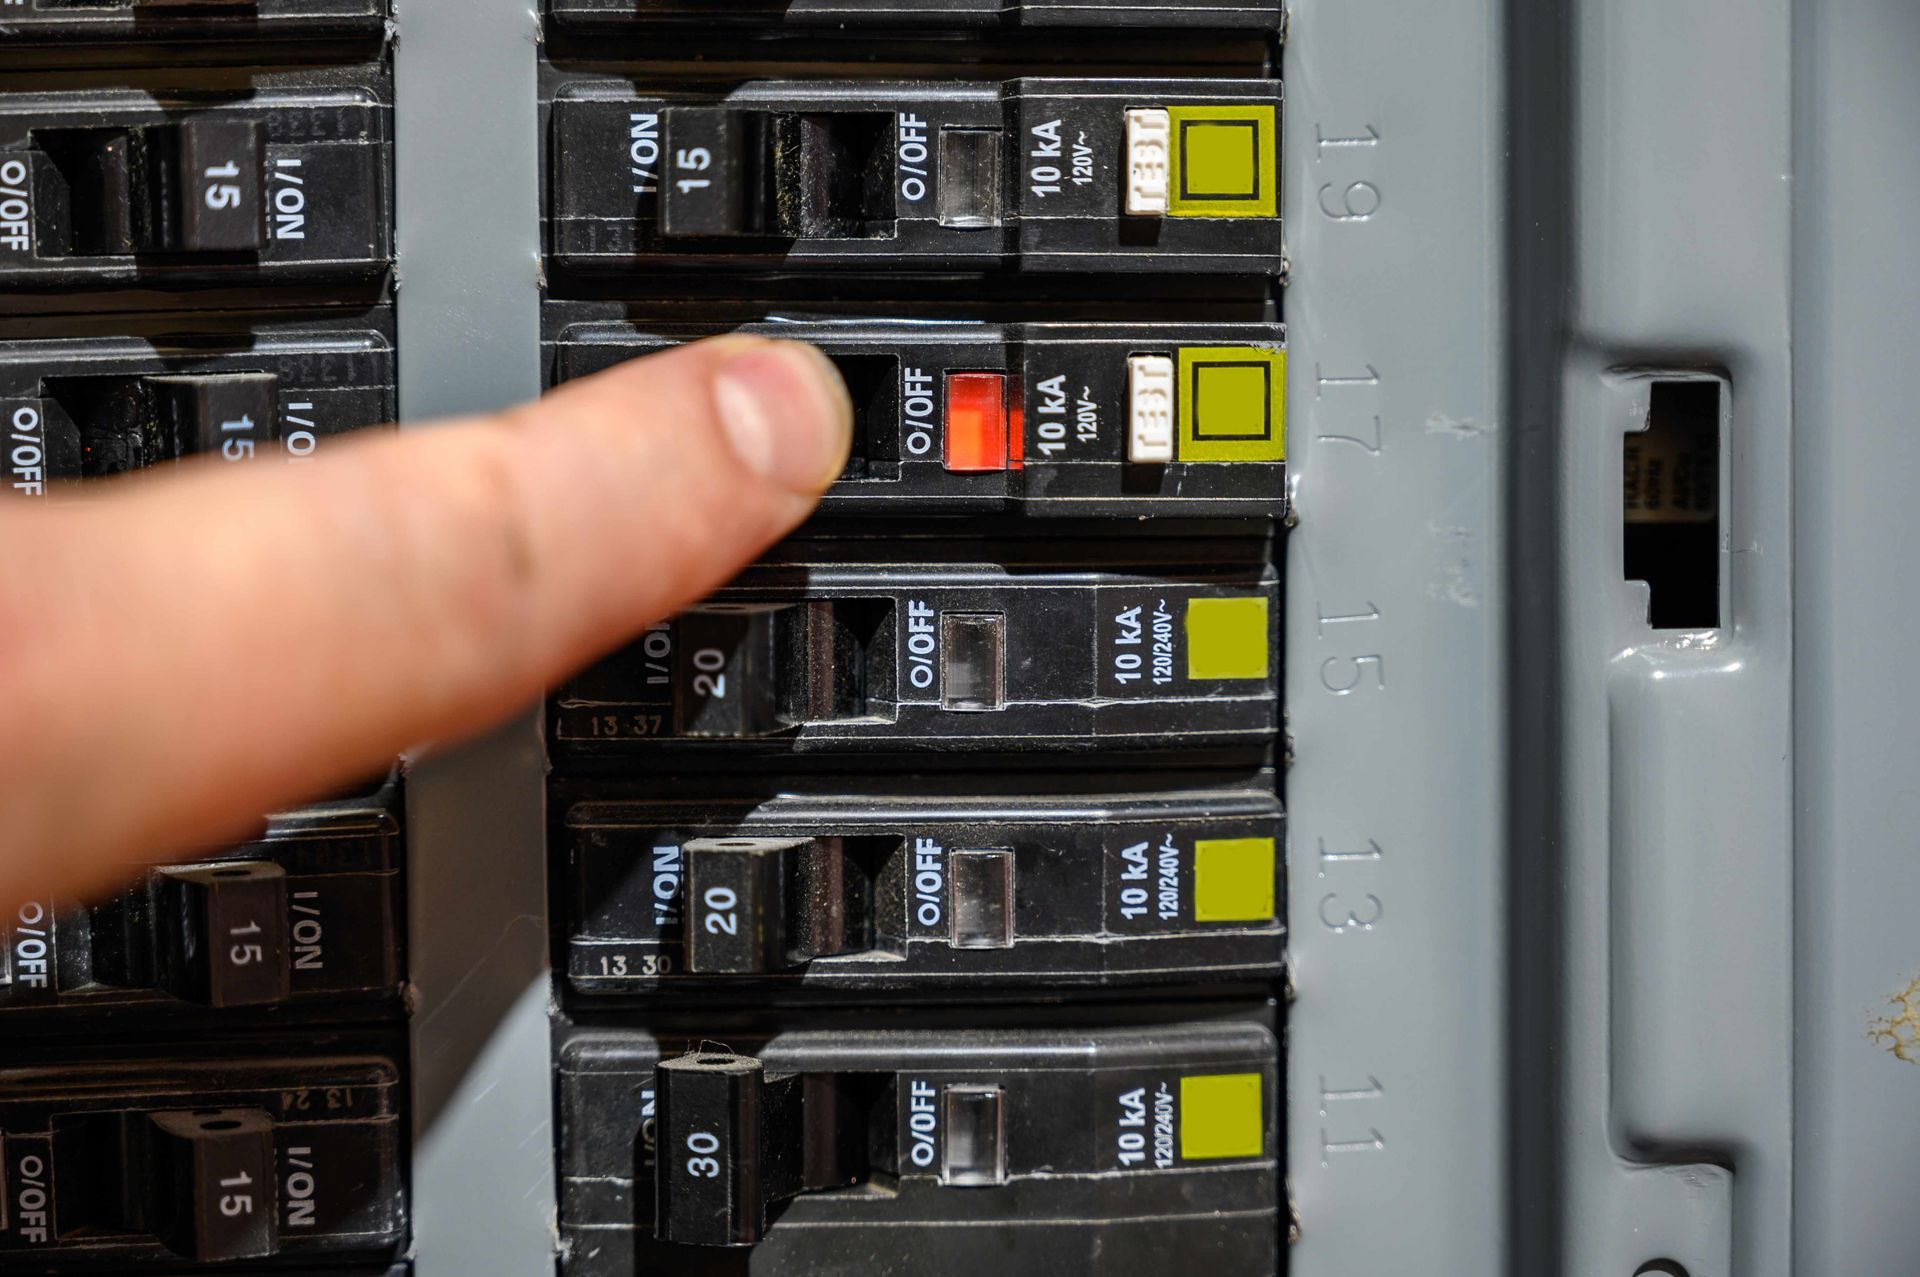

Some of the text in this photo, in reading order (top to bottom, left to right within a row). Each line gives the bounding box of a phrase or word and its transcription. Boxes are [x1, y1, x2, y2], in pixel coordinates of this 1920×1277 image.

[205, 161, 240, 209] 15
[631, 114, 658, 192] I/ON
[677, 148, 710, 193] 15
[899, 113, 927, 200] O/OFF
[1031, 120, 1061, 197] 10 kA
[1315, 122, 1381, 222] 19
[0, 161, 29, 250] O/OFF
[275, 159, 304, 239] I/ON
[221, 415, 255, 460] 15
[287, 402, 316, 464] I/O
[905, 368, 933, 454] O/OFF
[1037, 375, 1066, 455] 10 kA
[1315, 362, 1381, 456] 17
[11, 407, 43, 496] O/OFF
[695, 651, 725, 698] 20
[908, 600, 934, 687] O/OFF
[1115, 607, 1141, 684] 10 kA
[1317, 601, 1384, 696] 15
[653, 846, 679, 924] I/ON
[705, 887, 736, 935] 20
[916, 838, 942, 925] O/OFF
[1121, 842, 1148, 919] 10 kA
[1318, 837, 1384, 933] 13
[17, 901, 47, 988] O/OFF
[231, 922, 262, 965] 15
[292, 892, 322, 969] I/ON
[600, 955, 628, 976] 13
[687, 1133, 719, 1177] 30
[910, 1081, 935, 1166] O/OFF
[1119, 1088, 1145, 1165] 10 kA
[1320, 1075, 1385, 1169] 11
[19, 1156, 47, 1242] O/OFF
[220, 1172, 252, 1216] 15
[287, 1147, 315, 1225] I/ON
